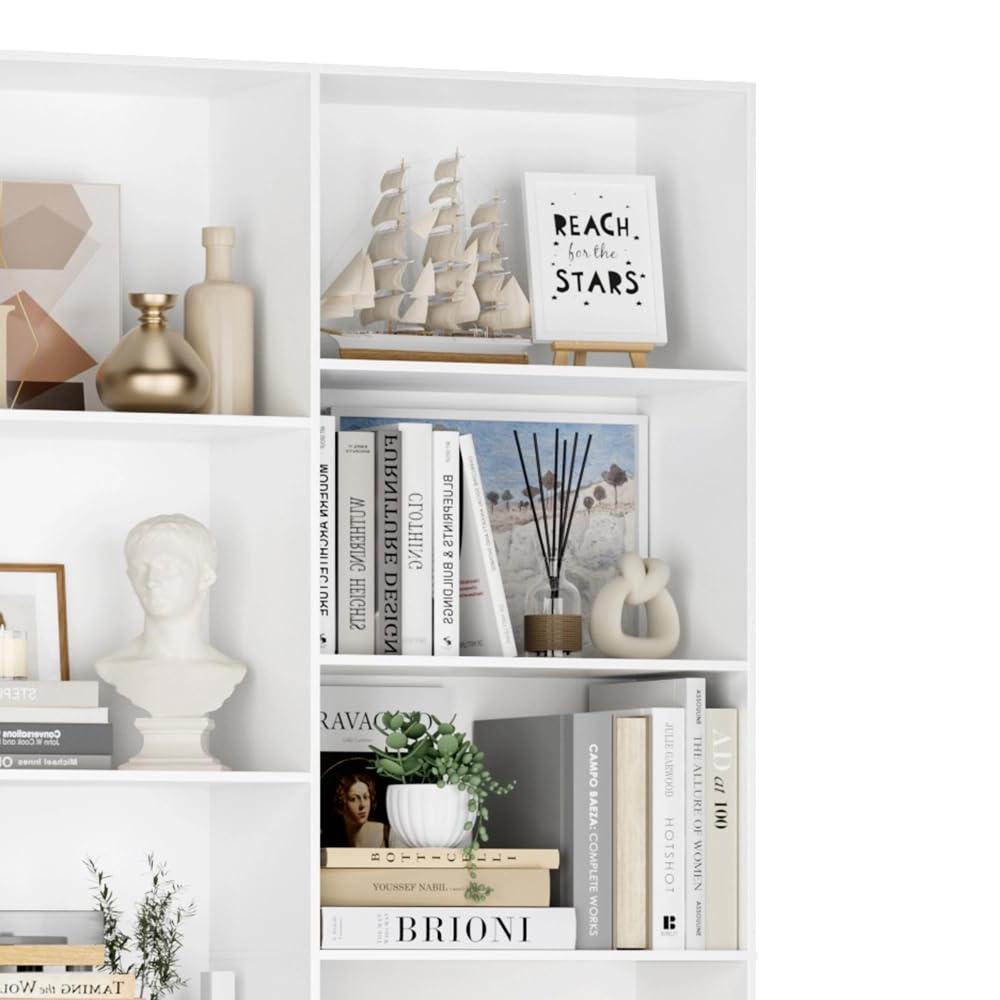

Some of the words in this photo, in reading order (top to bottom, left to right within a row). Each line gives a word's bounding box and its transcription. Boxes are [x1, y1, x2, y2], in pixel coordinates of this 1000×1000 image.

[554, 212, 628, 236] REACH
[568, 242, 590, 261] for
[592, 243, 617, 259] the
[556, 269, 638, 294] STARS
[694, 738, 702, 756] THE
[712, 729, 733, 772] AD
[589, 744, 600, 787] CAMPO
[694, 766, 702, 811] ALLURE
[714, 776, 725, 794] at
[589, 791, 600, 829] BAEZA:
[714, 802, 729, 829] 100
[694, 819, 702, 832] OF
[589, 833, 600, 891] COMPLETE
[664, 818, 674, 892] HOTSHOT
[694, 841, 702, 890] WOMEN
[373, 883, 416, 892] YOUSSEF
[419, 883, 448, 892] NABIL
[396, 916, 531, 943] BRIONI
[588, 896, 600, 936] WORKS
